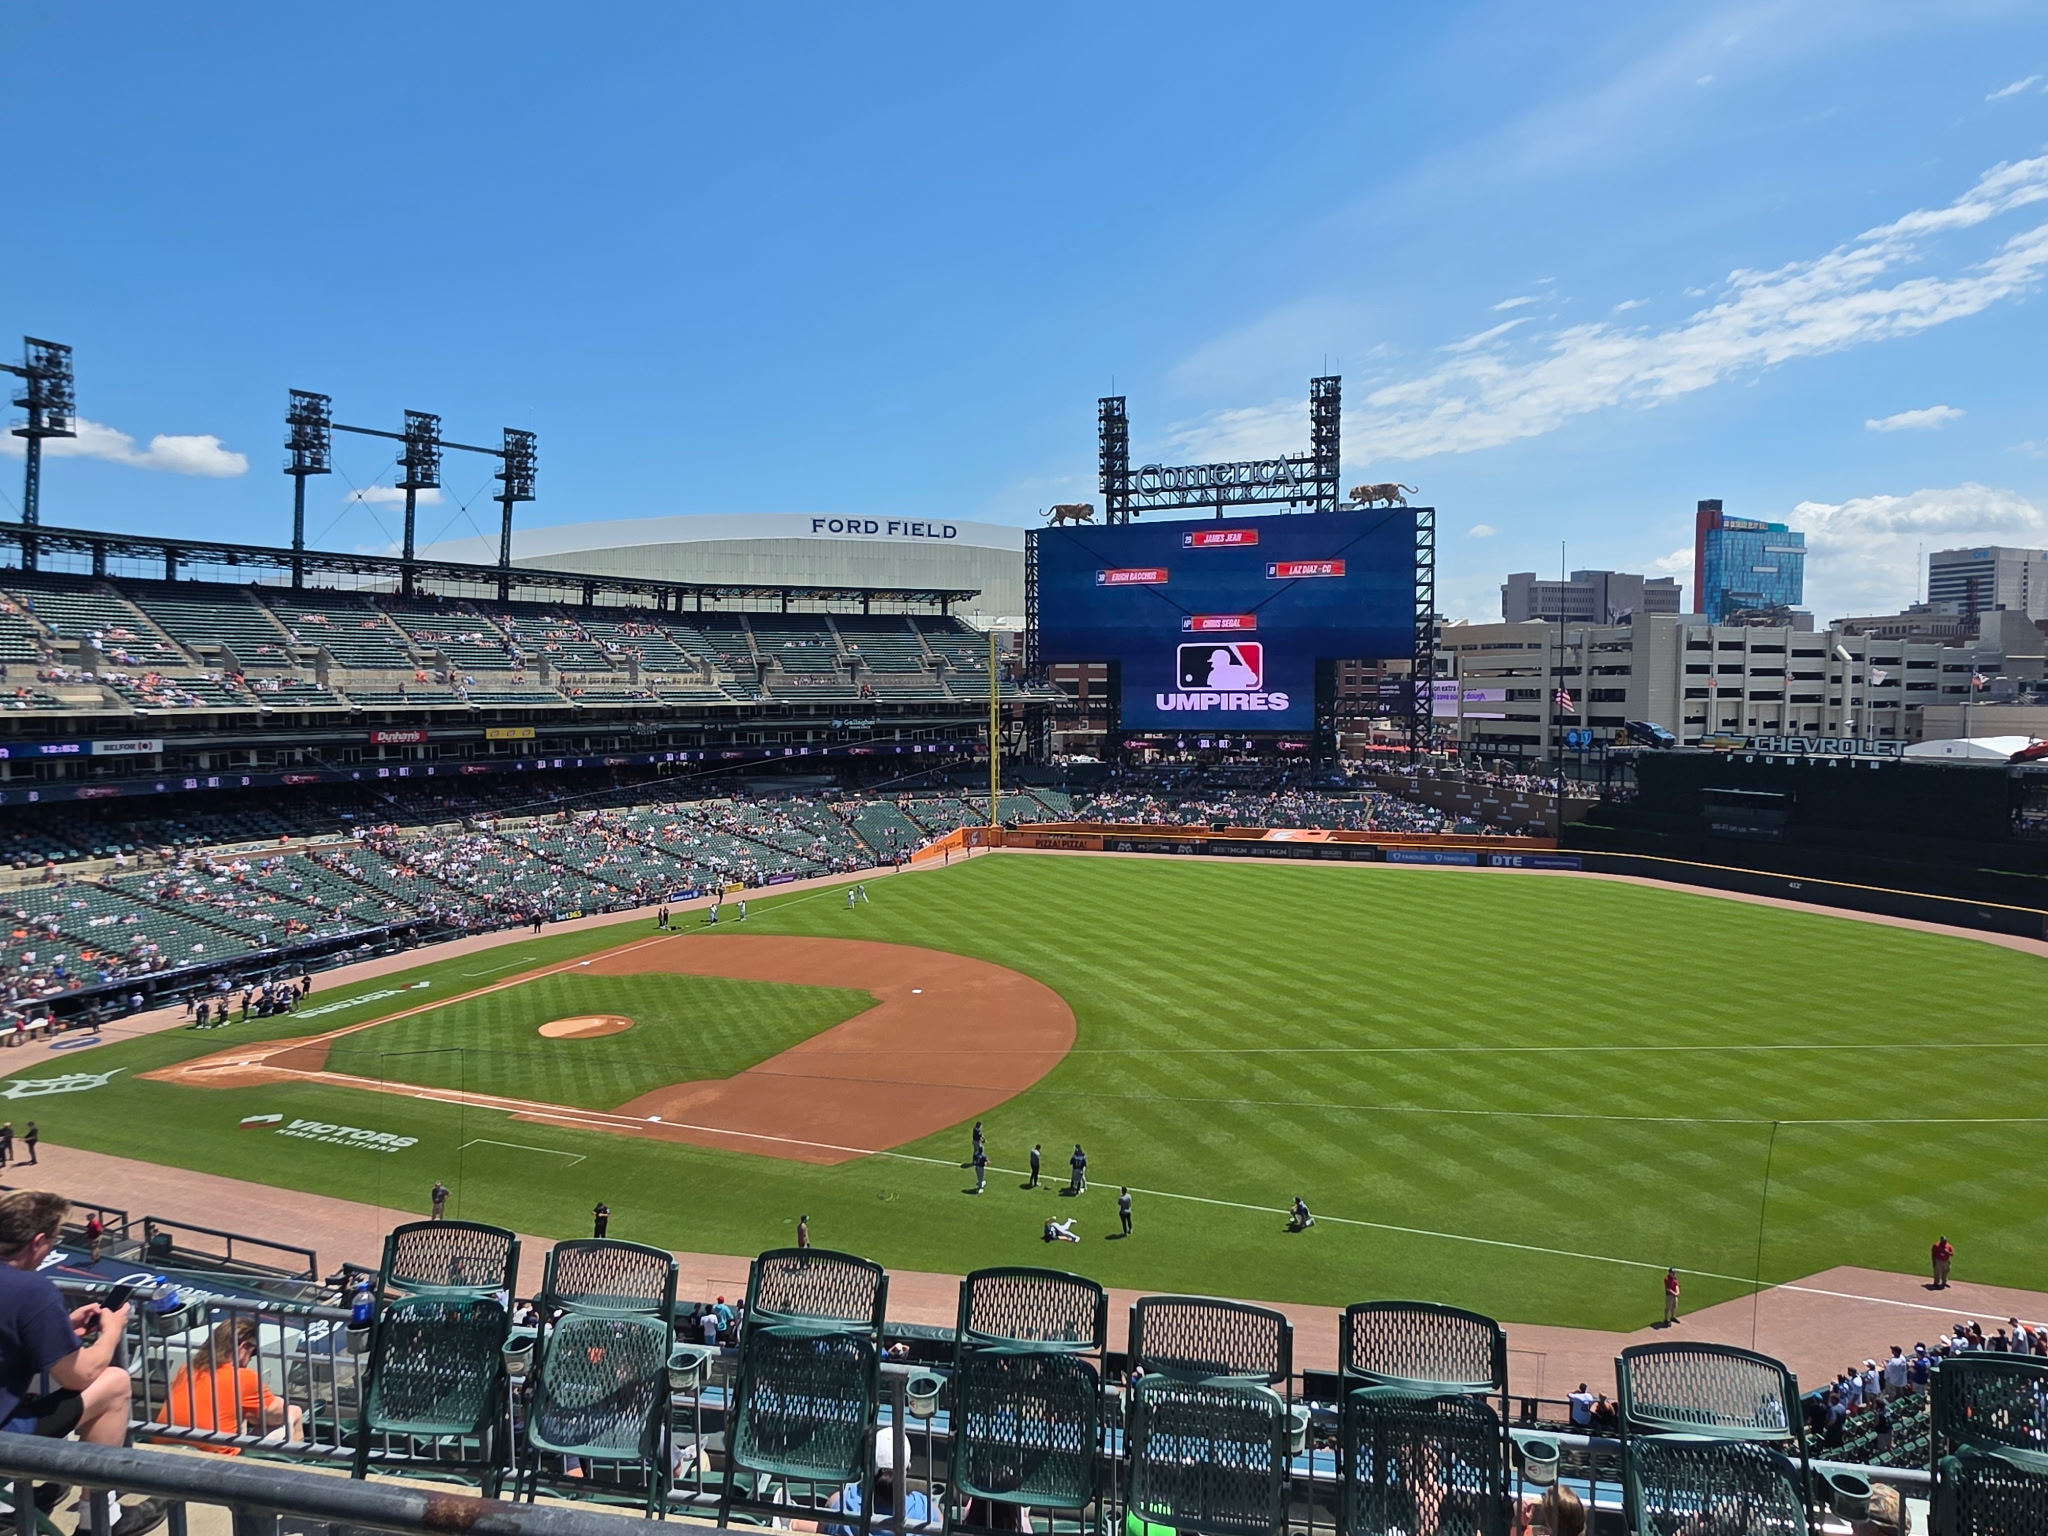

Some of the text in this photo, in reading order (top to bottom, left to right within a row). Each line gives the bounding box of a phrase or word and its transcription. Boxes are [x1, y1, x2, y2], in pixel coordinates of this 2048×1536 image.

[1178, 487, 1252, 503] PARK
[811, 518, 957, 538] FORD FIELD
[1204, 534, 1225, 543] JAMES
[1225, 533, 1242, 542] JEAN
[1289, 565, 1302, 574] LAZ
[1302, 565, 1318, 574] DIAZ
[1156, 692, 1289, 711] UMPIRES
[844, 718, 876, 727] Gallagher
[377, 731, 420, 741] Dunham's
[1754, 736, 1908, 757] CHEVROLET
[1726, 754, 1880, 769] FOUNTAIN
[1036, 839, 1087, 849] PIZZA! PIZZA!
[1492, 855, 1522, 867] DTE
[556, 910, 582, 920] bet365
[286, 1119, 419, 1147] VICTORS
[274, 1128, 400, 1152] HOME SOLUTIONS
